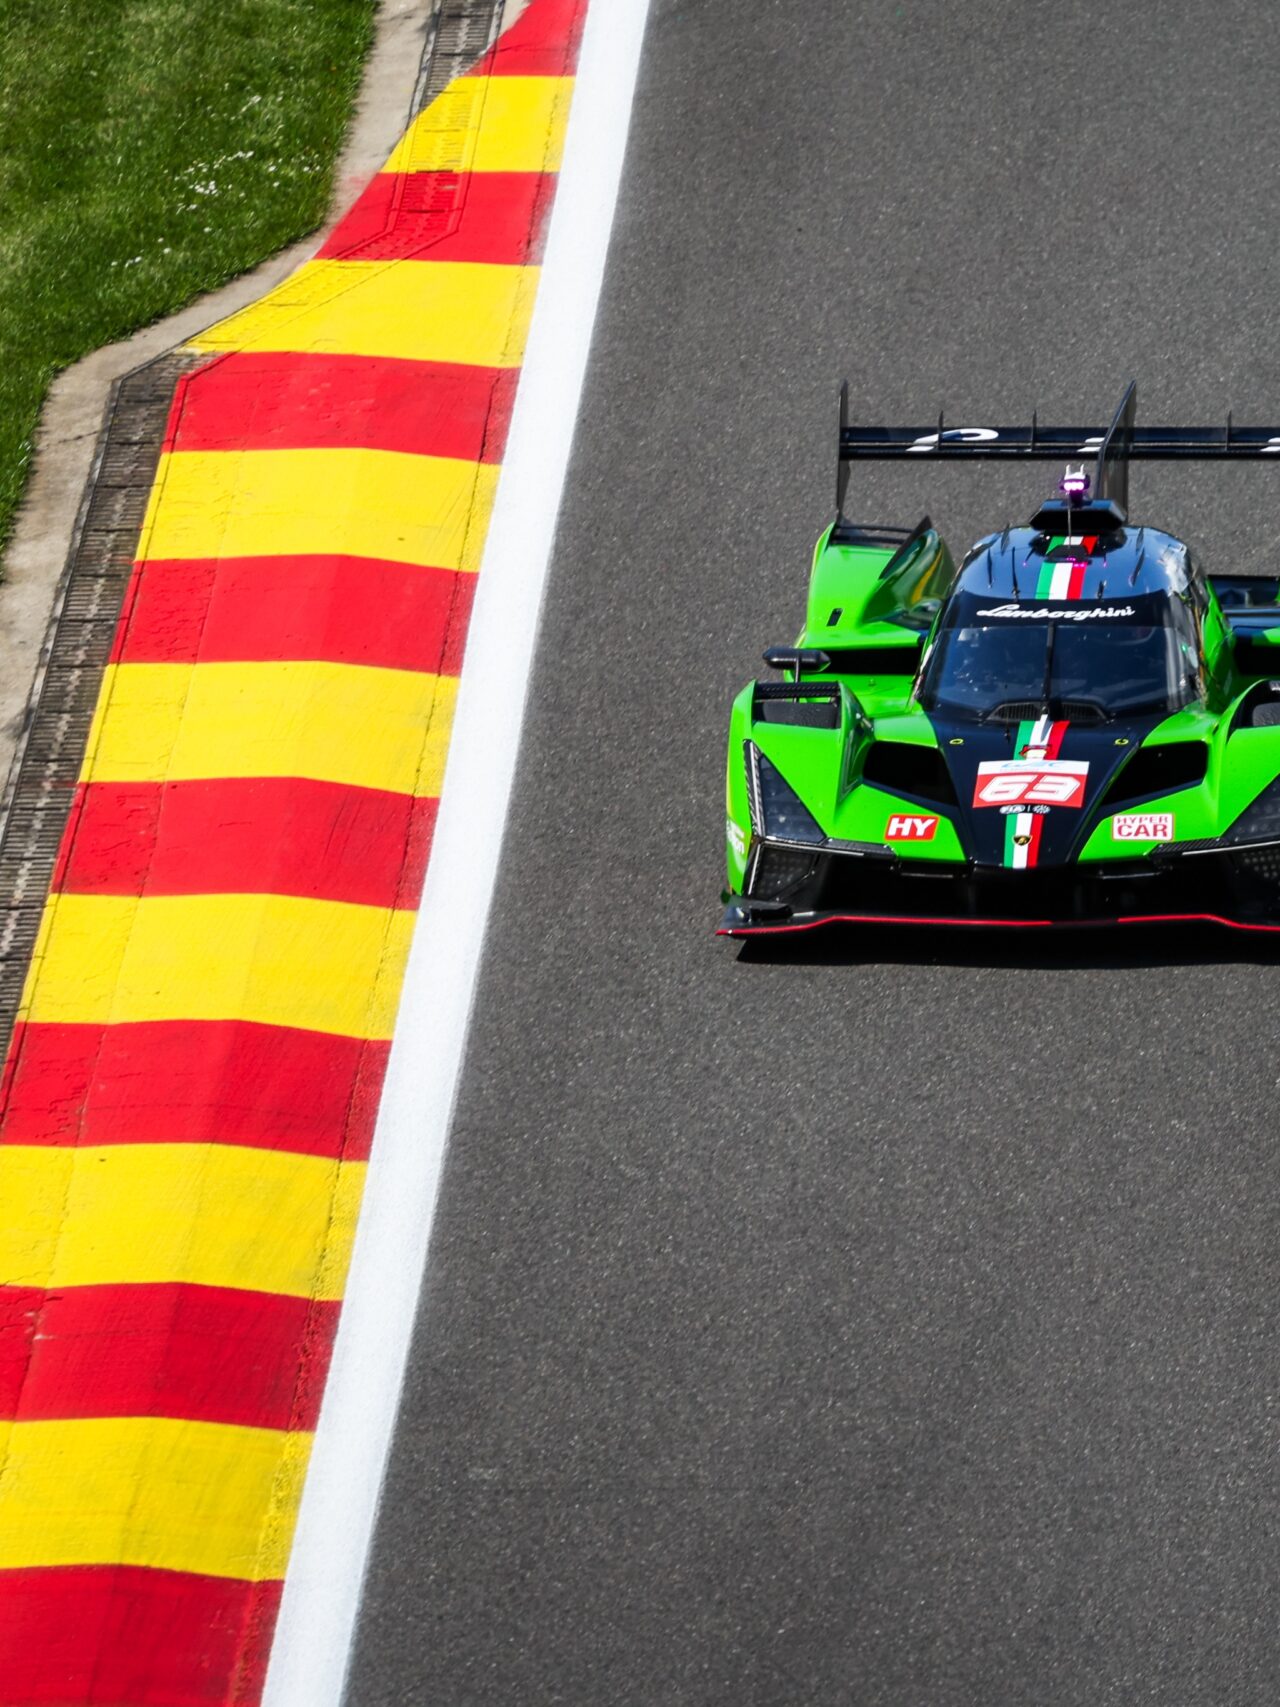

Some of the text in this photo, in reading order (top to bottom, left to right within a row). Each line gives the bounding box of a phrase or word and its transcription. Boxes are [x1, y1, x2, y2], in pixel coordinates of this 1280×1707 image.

[976, 604, 1135, 620] Lamborghini
[979, 774, 1081, 802] 63
[888, 817, 936, 836] HY
[1117, 824, 1168, 837] CAR
